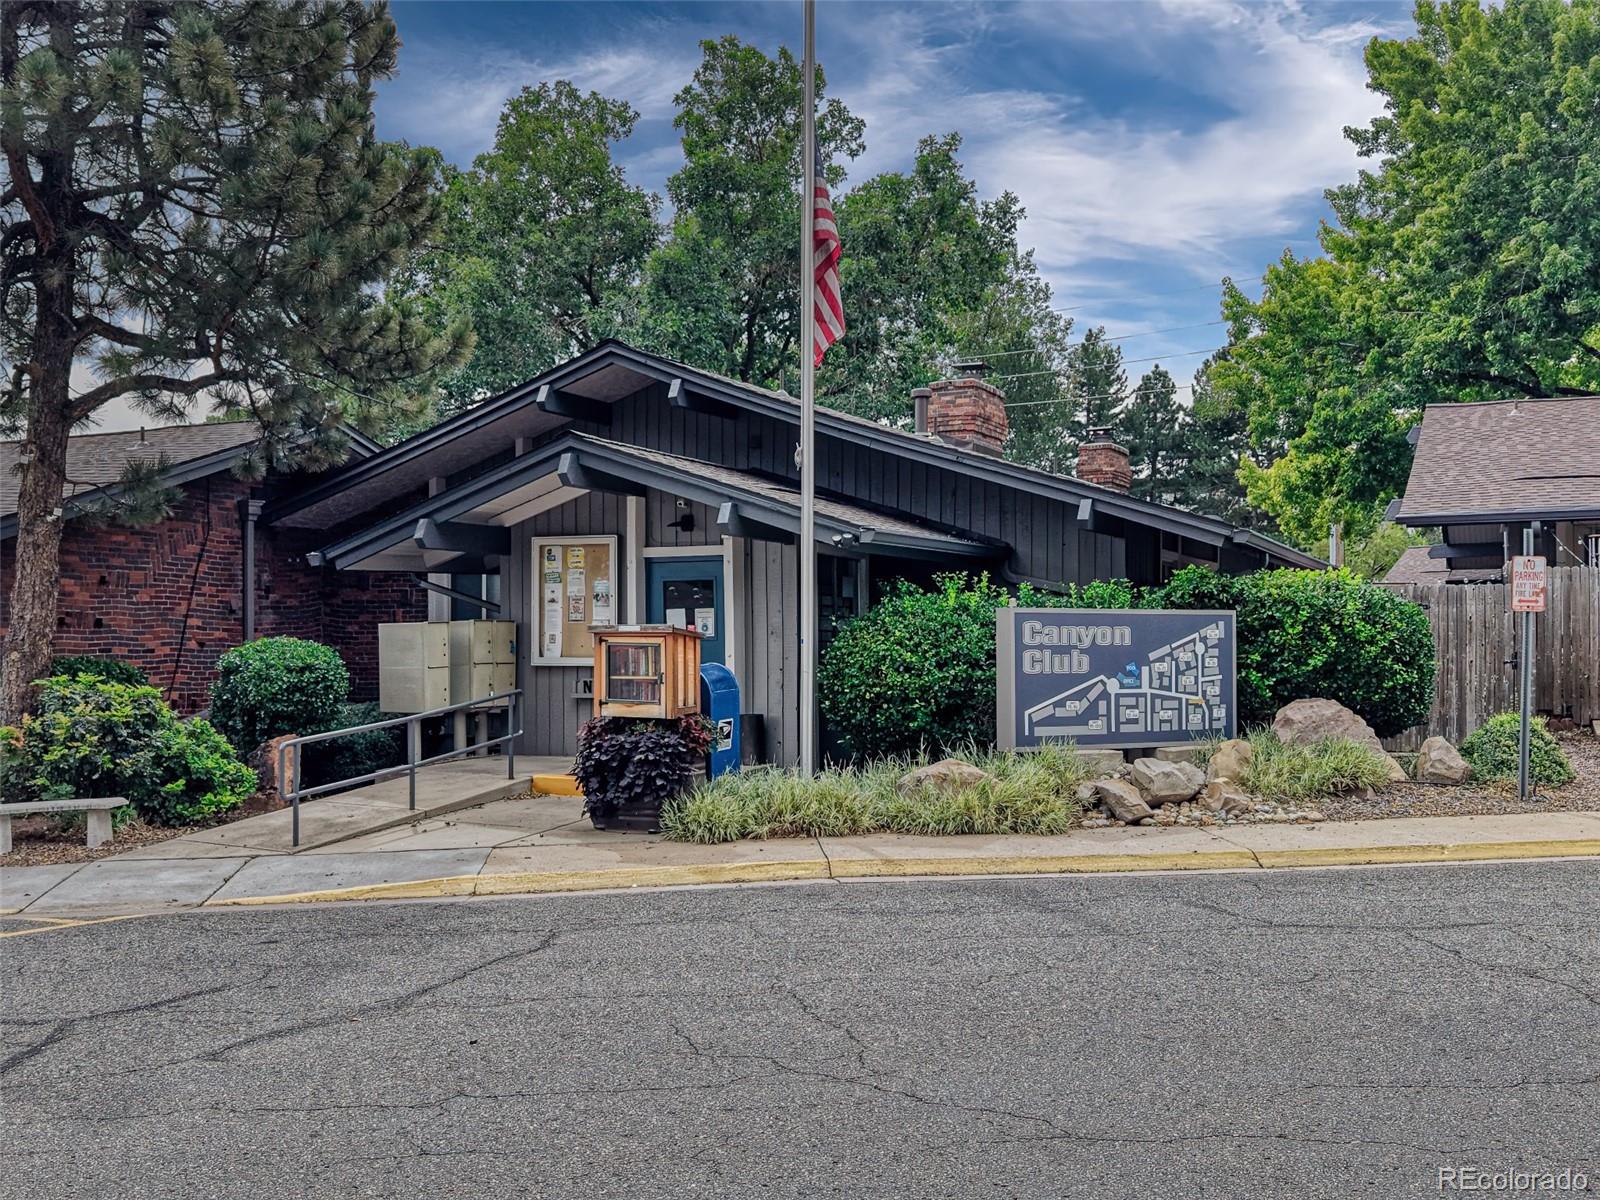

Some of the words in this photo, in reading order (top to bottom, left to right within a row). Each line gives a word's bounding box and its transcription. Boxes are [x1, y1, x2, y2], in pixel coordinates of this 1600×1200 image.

[1523, 560, 1535, 570] NO
[1515, 571, 1543, 581] PARKING
[1022, 620, 1132, 648] Canyon
[1022, 649, 1090, 674] Club
